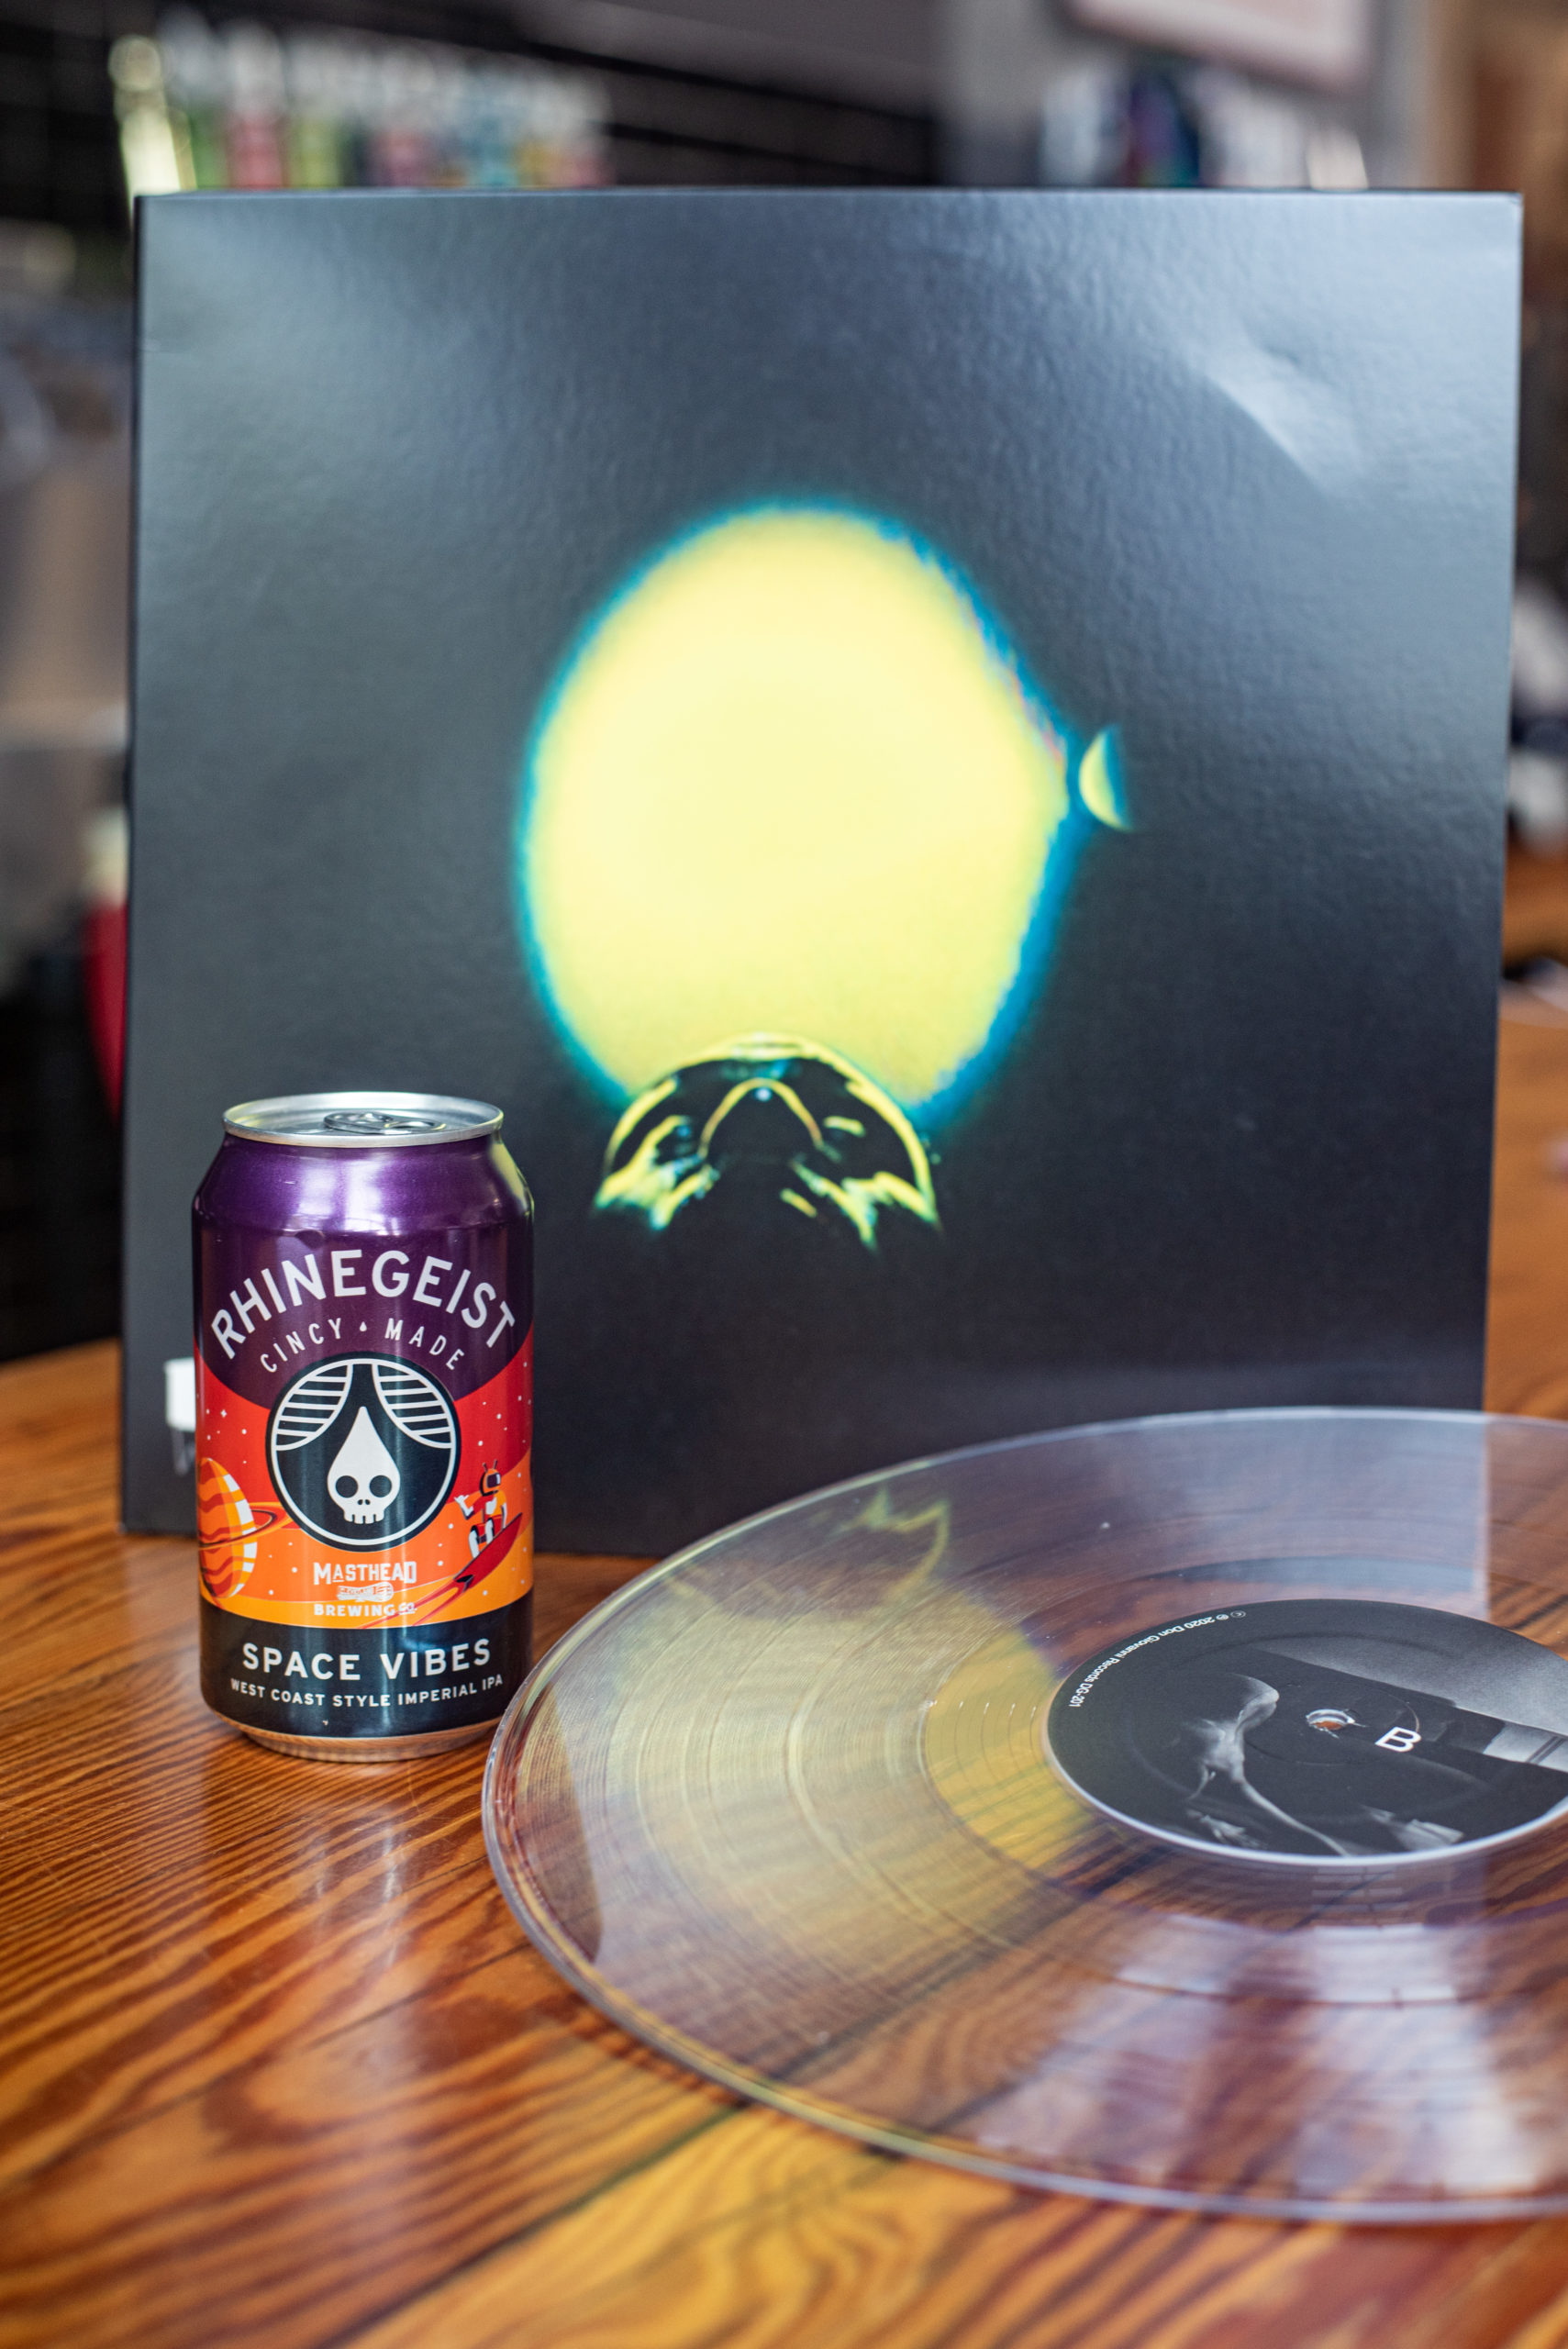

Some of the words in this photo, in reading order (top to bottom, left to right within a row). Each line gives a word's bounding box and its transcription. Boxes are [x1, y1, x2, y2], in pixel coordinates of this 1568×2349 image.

[211, 1249, 516, 1359] RHINEGEIST
[260, 1318, 341, 1373] CINCY
[384, 1318, 464, 1370] MADE
[313, 1561, 417, 1586] MASTHEAD
[314, 1603, 395, 1617] BREWING
[1183, 1616, 1216, 1629] 2020
[1157, 1625, 1185, 1637] Don
[242, 1642, 361, 1680] SPACE
[380, 1638, 490, 1680] VIBES
[1114, 1635, 1160, 1658] Giovanni
[1084, 1657, 1120, 1683] Records
[230, 1677, 265, 1698] WEST
[271, 1688, 326, 1706] COAST
[332, 1694, 391, 1708] STYLE
[397, 1682, 477, 1706] IMPERIAL
[482, 1674, 503, 1690] IPA
[1068, 1683, 1094, 1707] DG-201
[1375, 1726, 1421, 1753] B
